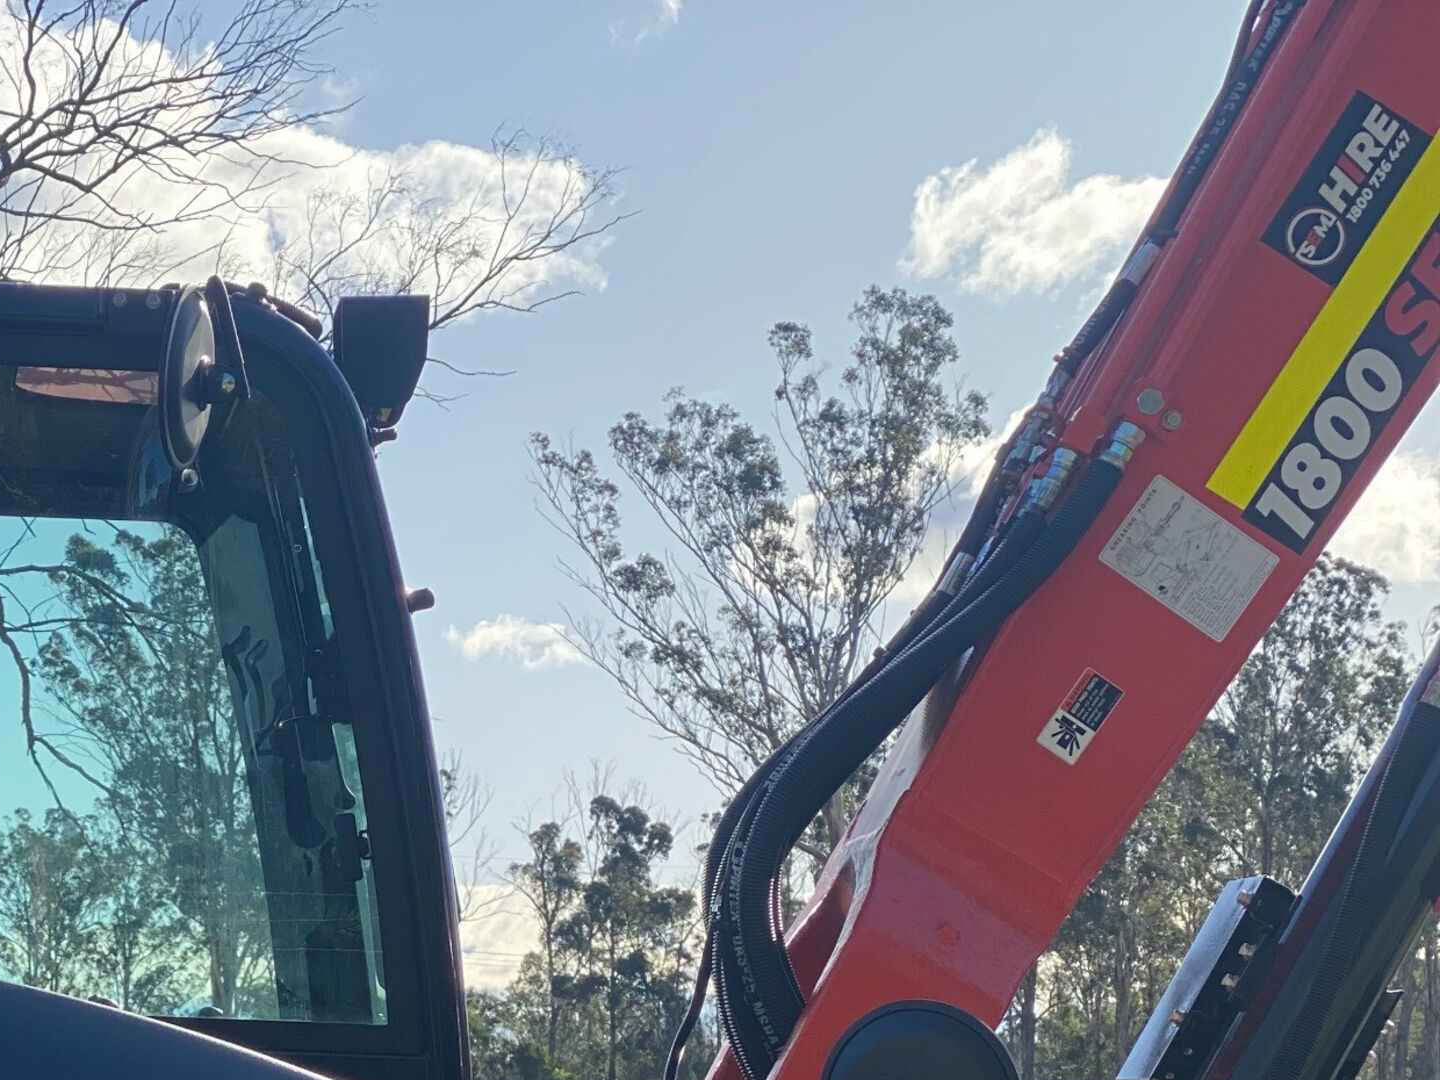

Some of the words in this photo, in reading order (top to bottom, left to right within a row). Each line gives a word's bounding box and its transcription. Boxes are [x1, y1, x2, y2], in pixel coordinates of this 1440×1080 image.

[1318, 103, 1400, 214] HIRE
[1346, 187, 1374, 223] 1800
[1369, 159, 1393, 189] 736
[1388, 129, 1411, 162] 447
[1297, 214, 1336, 259] SEM
[1255, 348, 1403, 540] 1800
[1110, 517, 1138, 552] GREASING
[1137, 487, 1159, 515] POINTS
